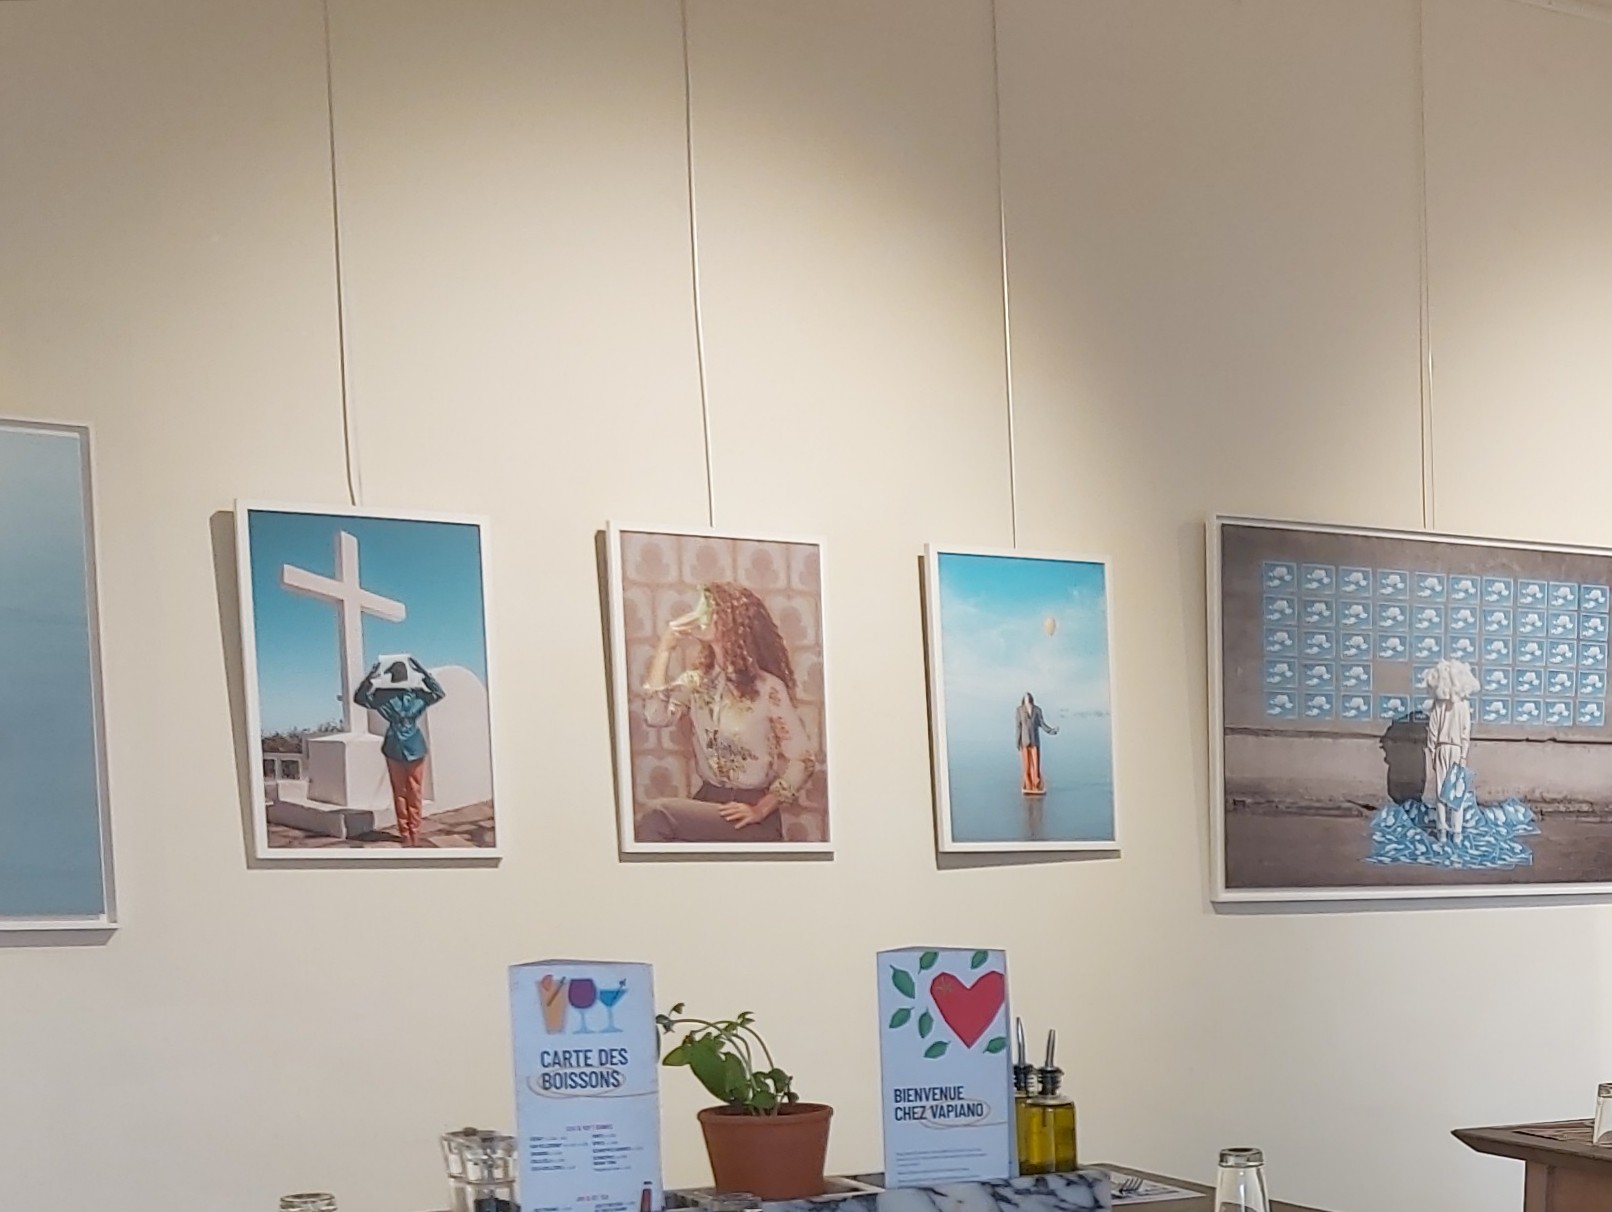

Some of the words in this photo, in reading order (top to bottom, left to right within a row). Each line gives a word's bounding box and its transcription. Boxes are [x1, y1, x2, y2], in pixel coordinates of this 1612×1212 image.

[540, 1049, 593, 1068] CARTE
[599, 1048, 629, 1066] DES
[542, 1070, 621, 1090] BOISSONS
[893, 1086, 965, 1103] BIENVENUE
[894, 1105, 927, 1121] CHEZ
[930, 1103, 984, 1119] VAPIANO
